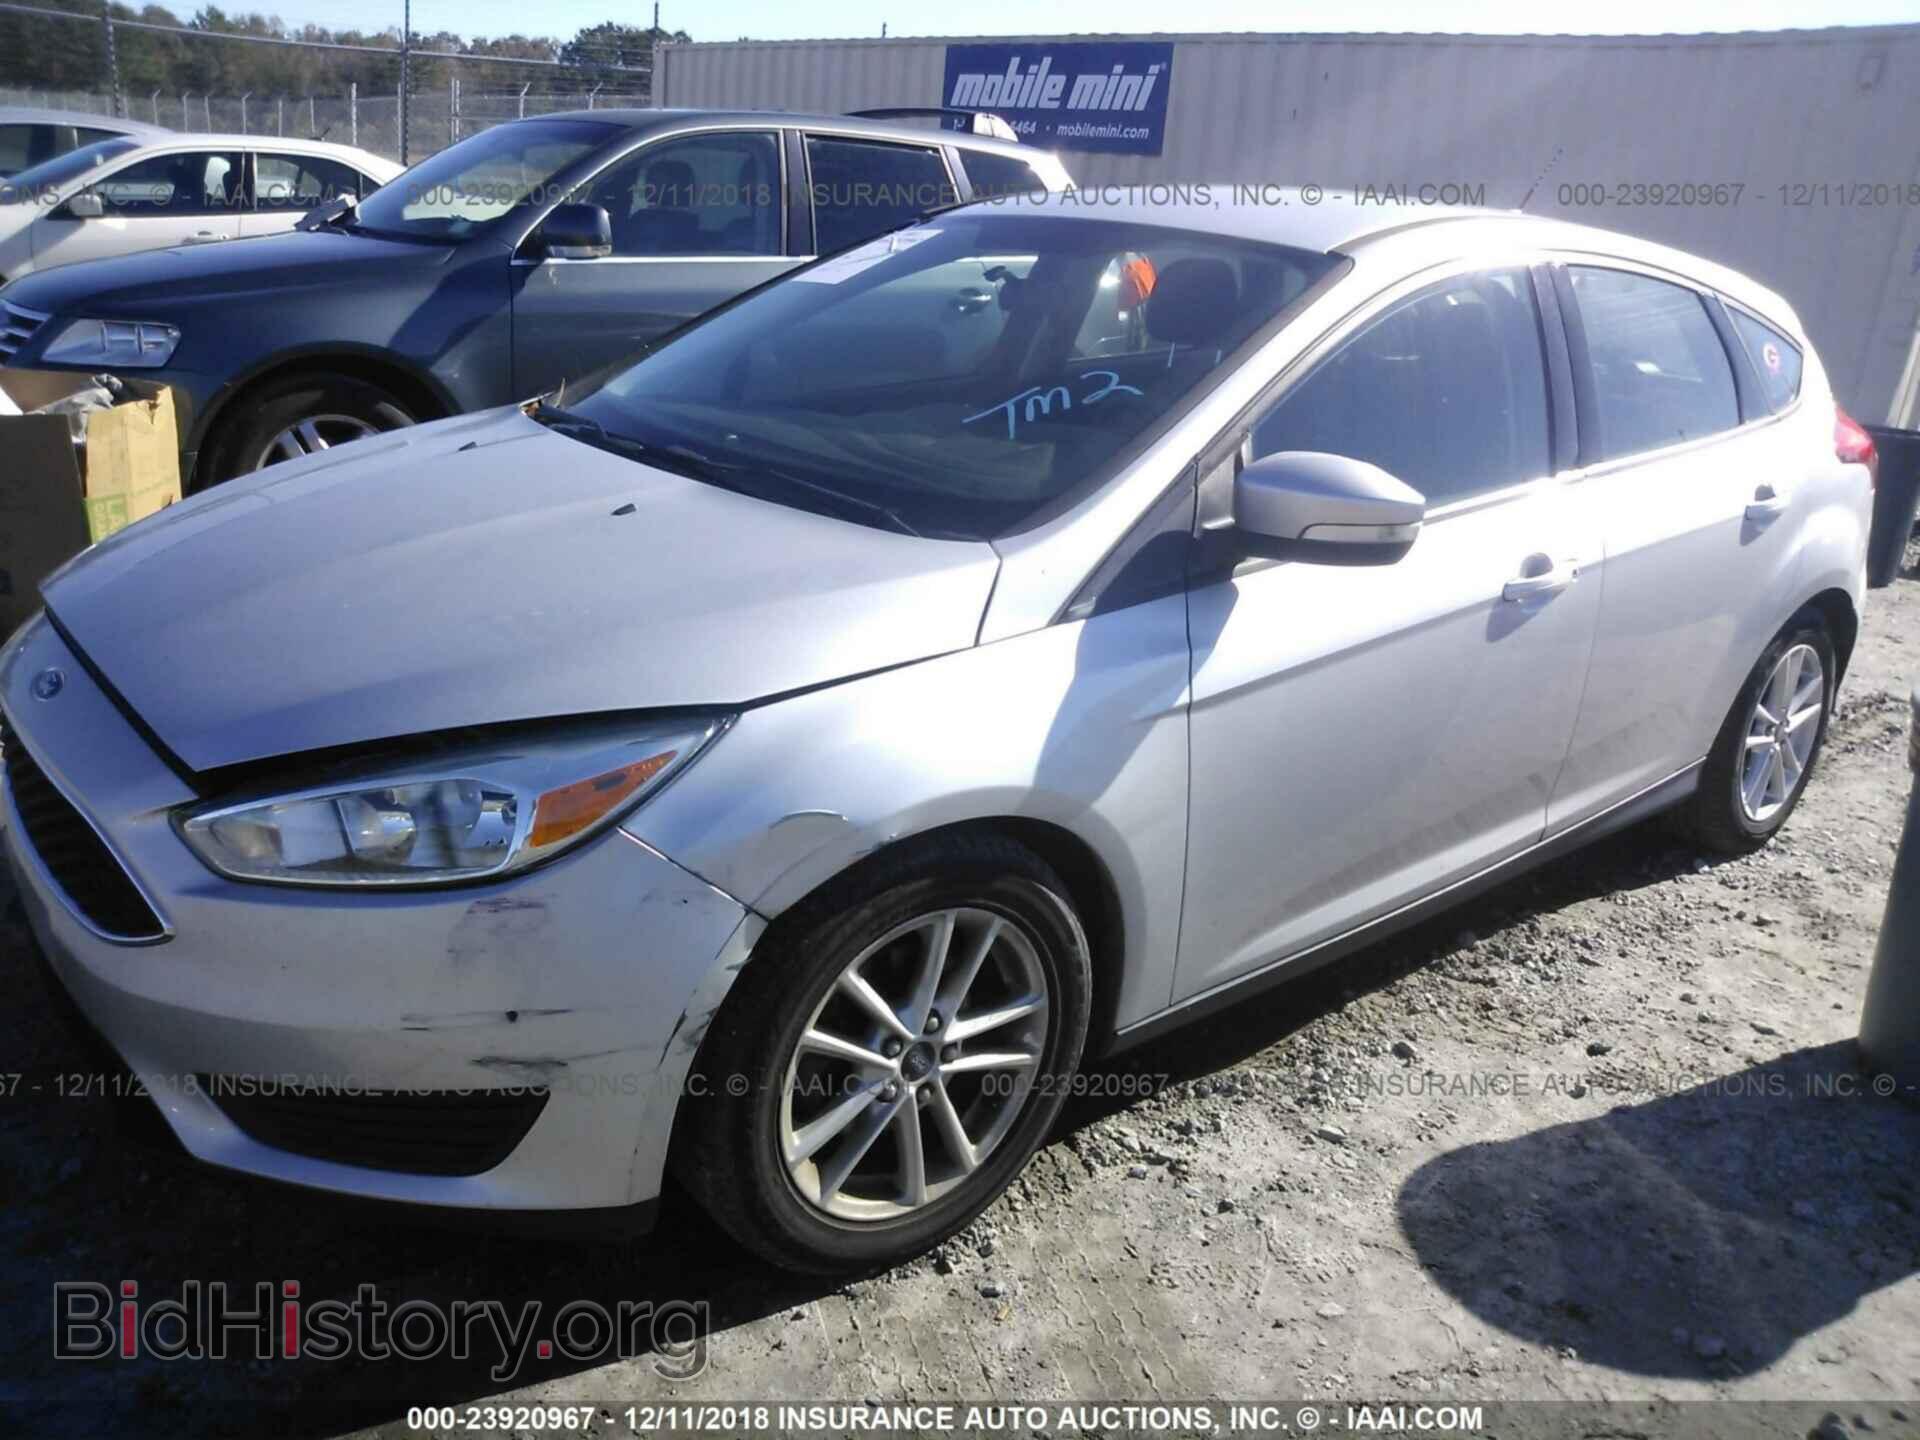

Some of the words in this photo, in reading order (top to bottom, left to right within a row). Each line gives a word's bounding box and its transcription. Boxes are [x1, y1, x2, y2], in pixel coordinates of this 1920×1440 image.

[951, 57, 1067, 109] mobile
[1066, 65, 1160, 111] mini
[1056, 122, 1149, 139] mobilemini.com
